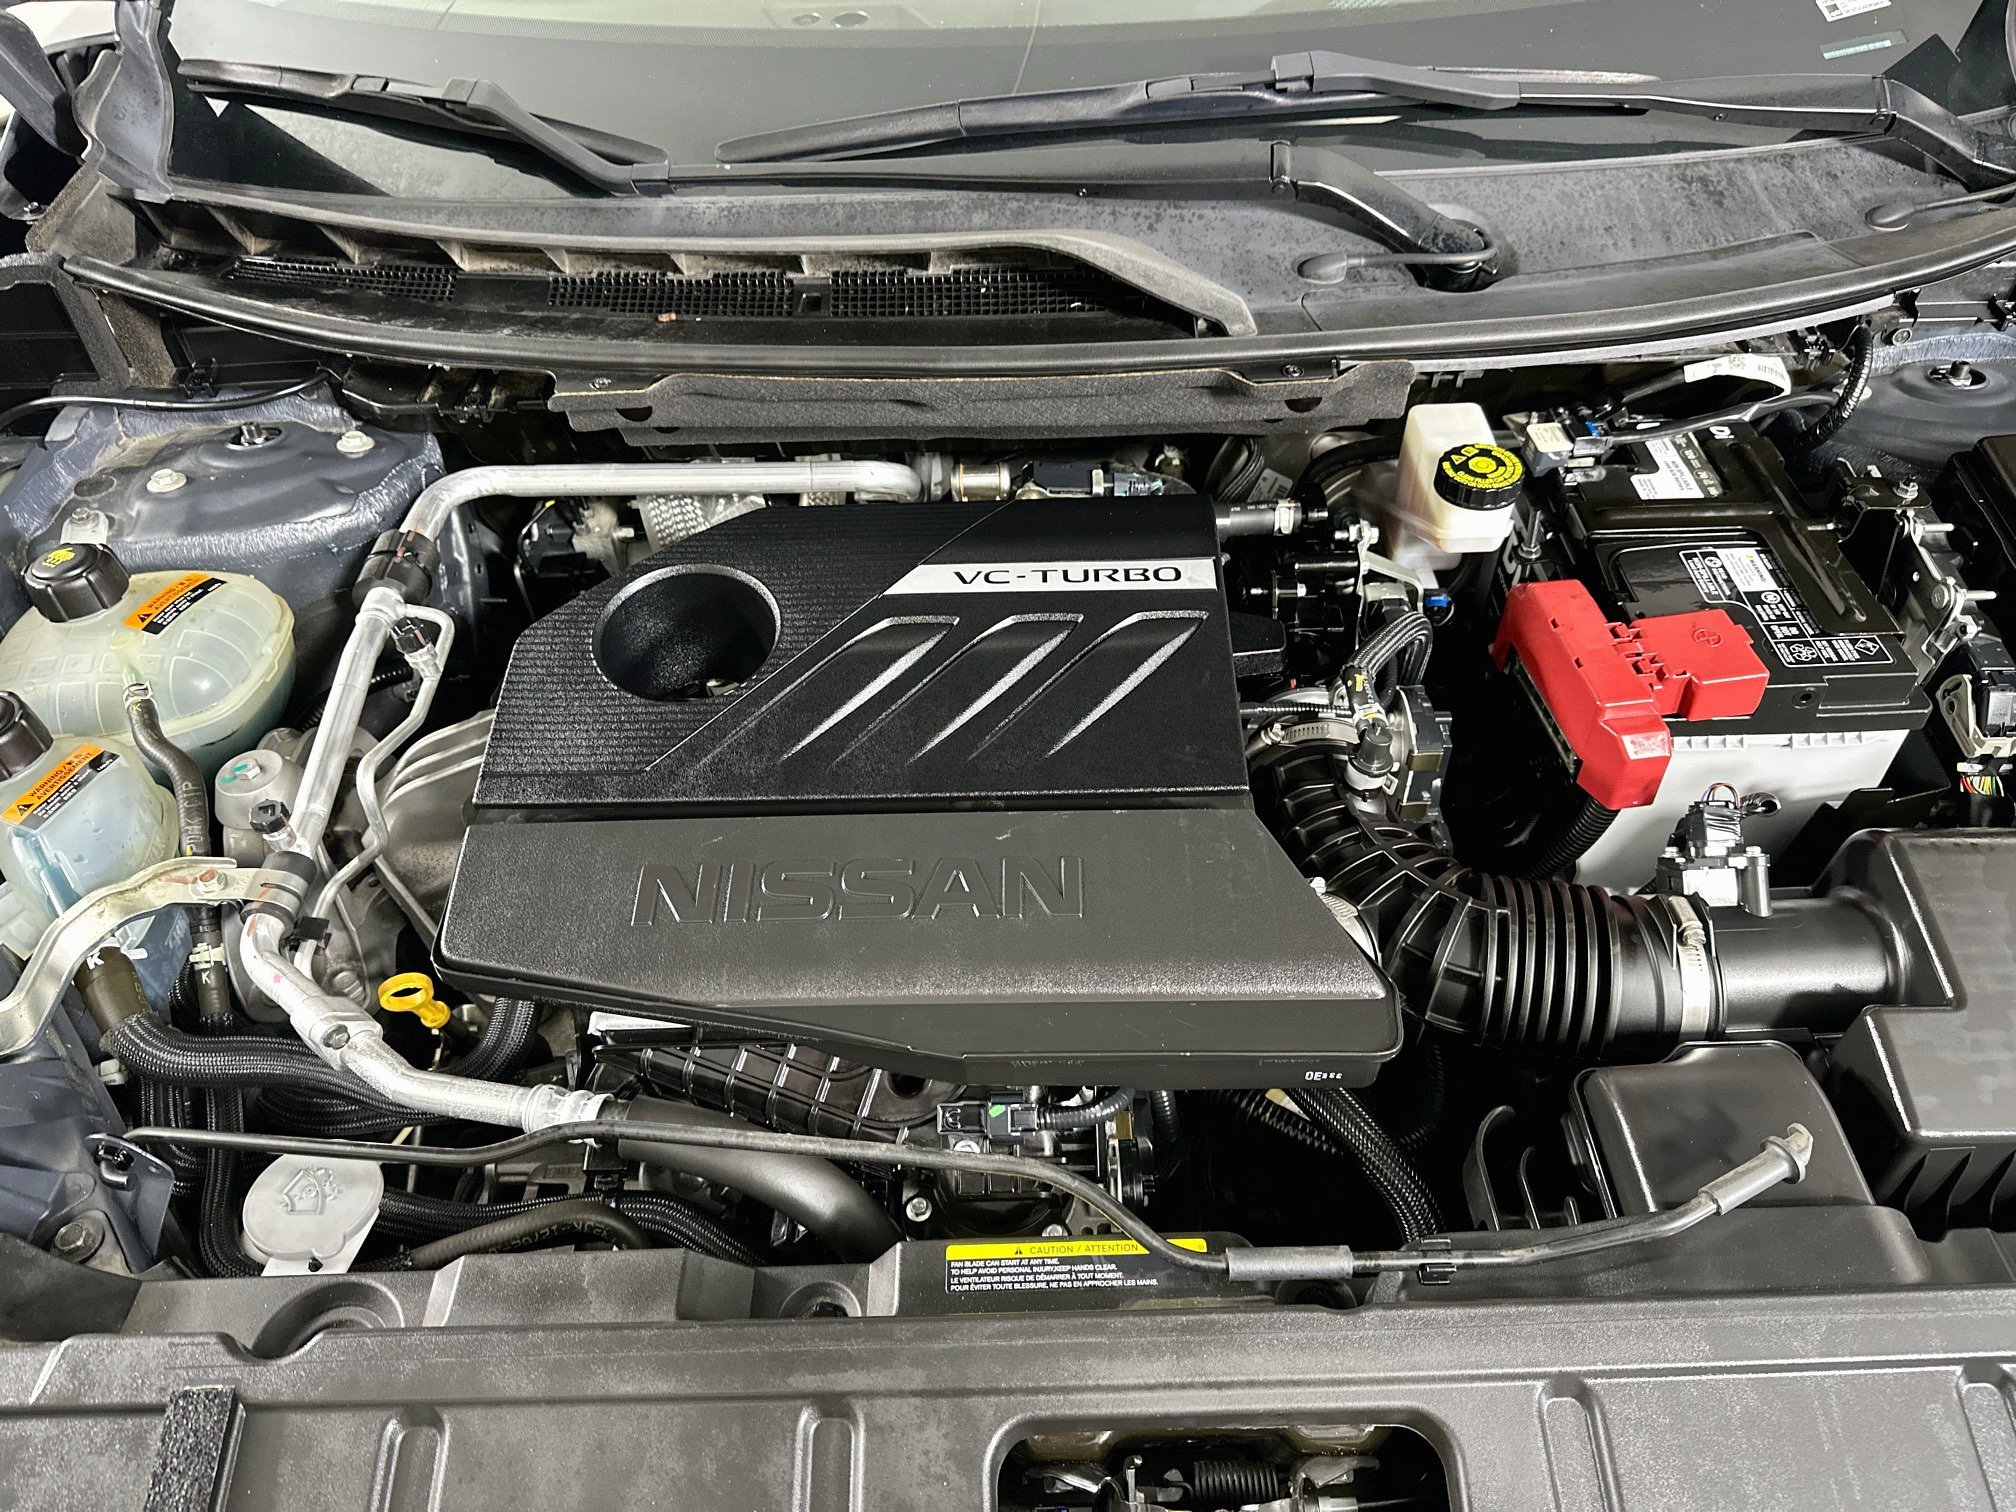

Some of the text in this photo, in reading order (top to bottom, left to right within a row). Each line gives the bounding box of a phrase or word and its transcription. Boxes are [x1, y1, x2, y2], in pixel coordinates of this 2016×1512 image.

[953, 566, 1182, 586] VC-TURBO
[631, 857, 1083, 926] NISSAN
[86, 951, 105, 970] K
[201, 971, 211, 985] K
[1030, 1246, 1074, 1255] CAUTION
[1085, 1243, 1139, 1254] ATTENTION
[950, 1268, 960, 1276] TO
[959, 1275, 1001, 1283] VENTILATEUR
[1035, 1273, 1071, 1281] DÉMARRER
[1095, 1271, 1124, 1279] MOMENT.
[970, 1282, 992, 1290] ÉVITER
[1013, 1281, 1049, 1289] BLESSURE,
